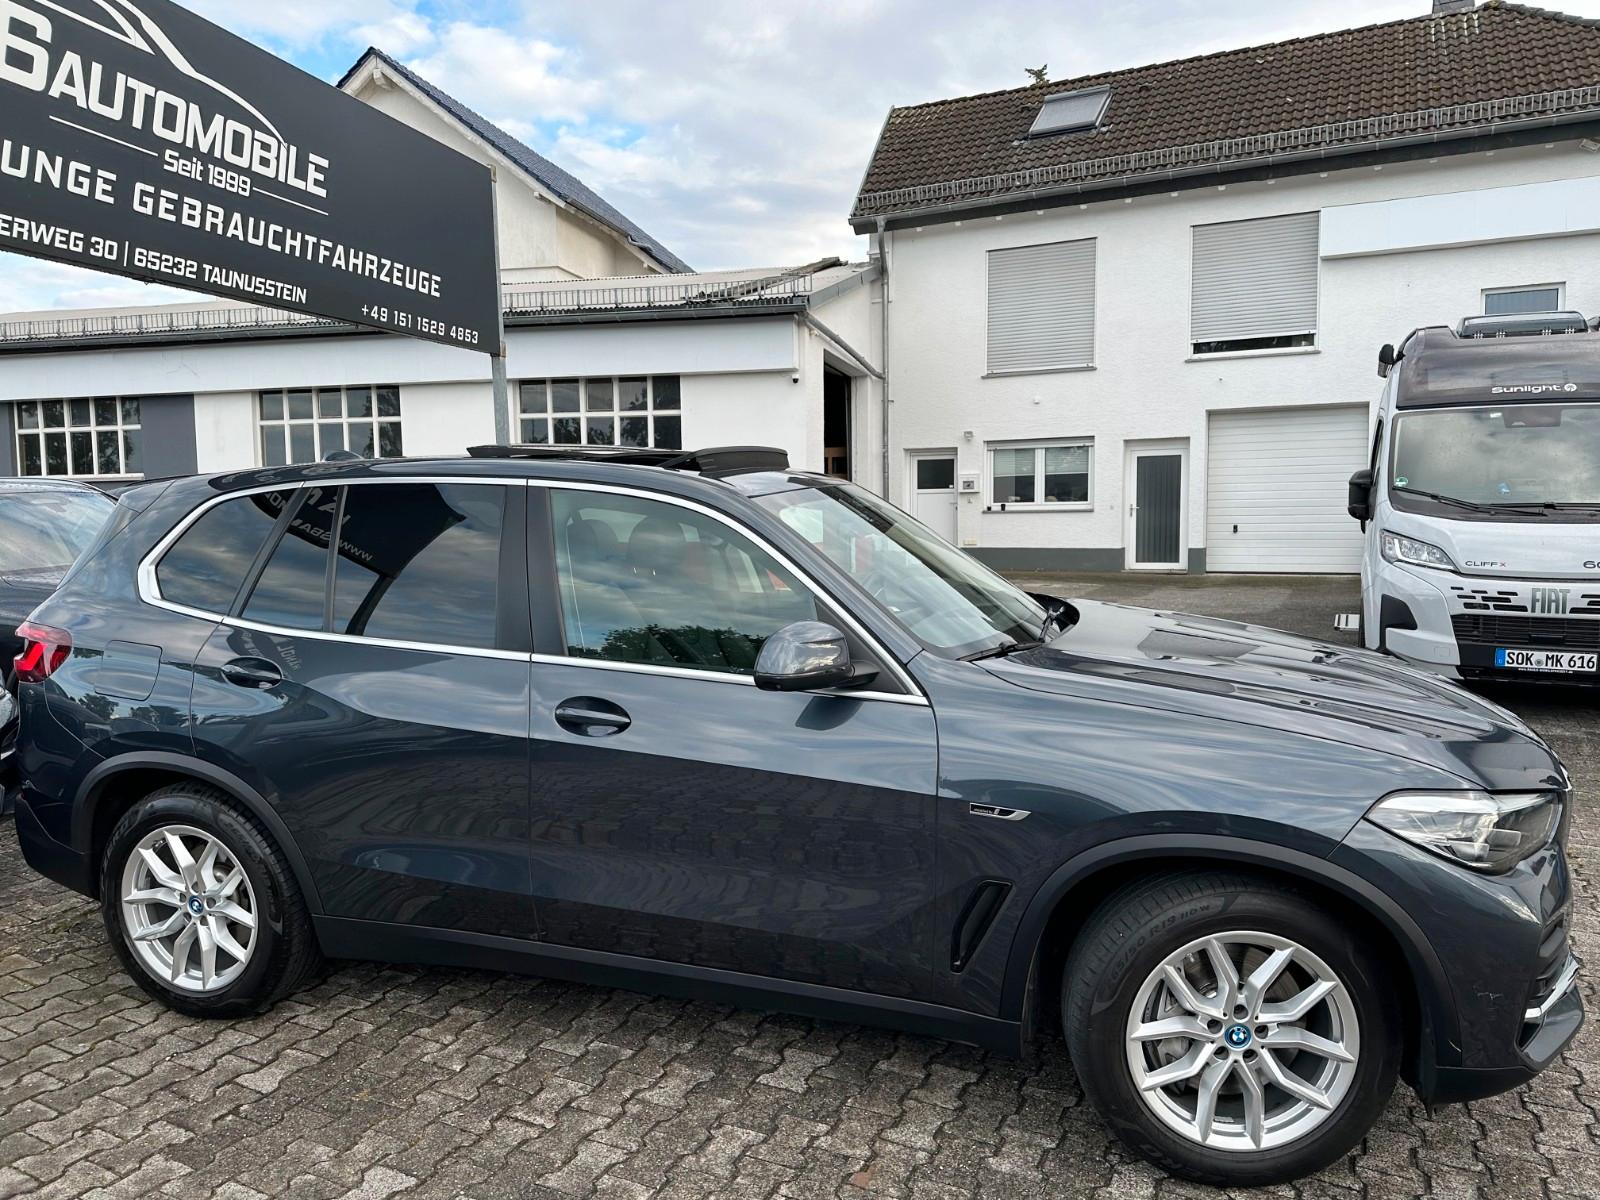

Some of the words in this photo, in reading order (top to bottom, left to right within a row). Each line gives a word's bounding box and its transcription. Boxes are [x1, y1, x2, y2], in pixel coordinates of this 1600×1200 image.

[163, 149, 204, 182] Seit
[207, 163, 251, 197] 1999
[132, 181, 442, 298] GEBRAUCHTFAHRZEUGE
[90, 236, 118, 261] 30
[134, 247, 198, 279] 65232
[202, 263, 307, 304] TAUNUSSTEIN
[361, 304, 388, 322] +49
[393, 310, 412, 328] 151
[417, 316, 445, 336] 1529
[449, 325, 479, 344] 4853
[1583, 560, 1600, 569] 6
[1530, 587, 1571, 615] FIAT
[1506, 651, 1535, 666] SOK
[1545, 653, 1564, 668] MK
[1567, 655, 1596, 669] 616
